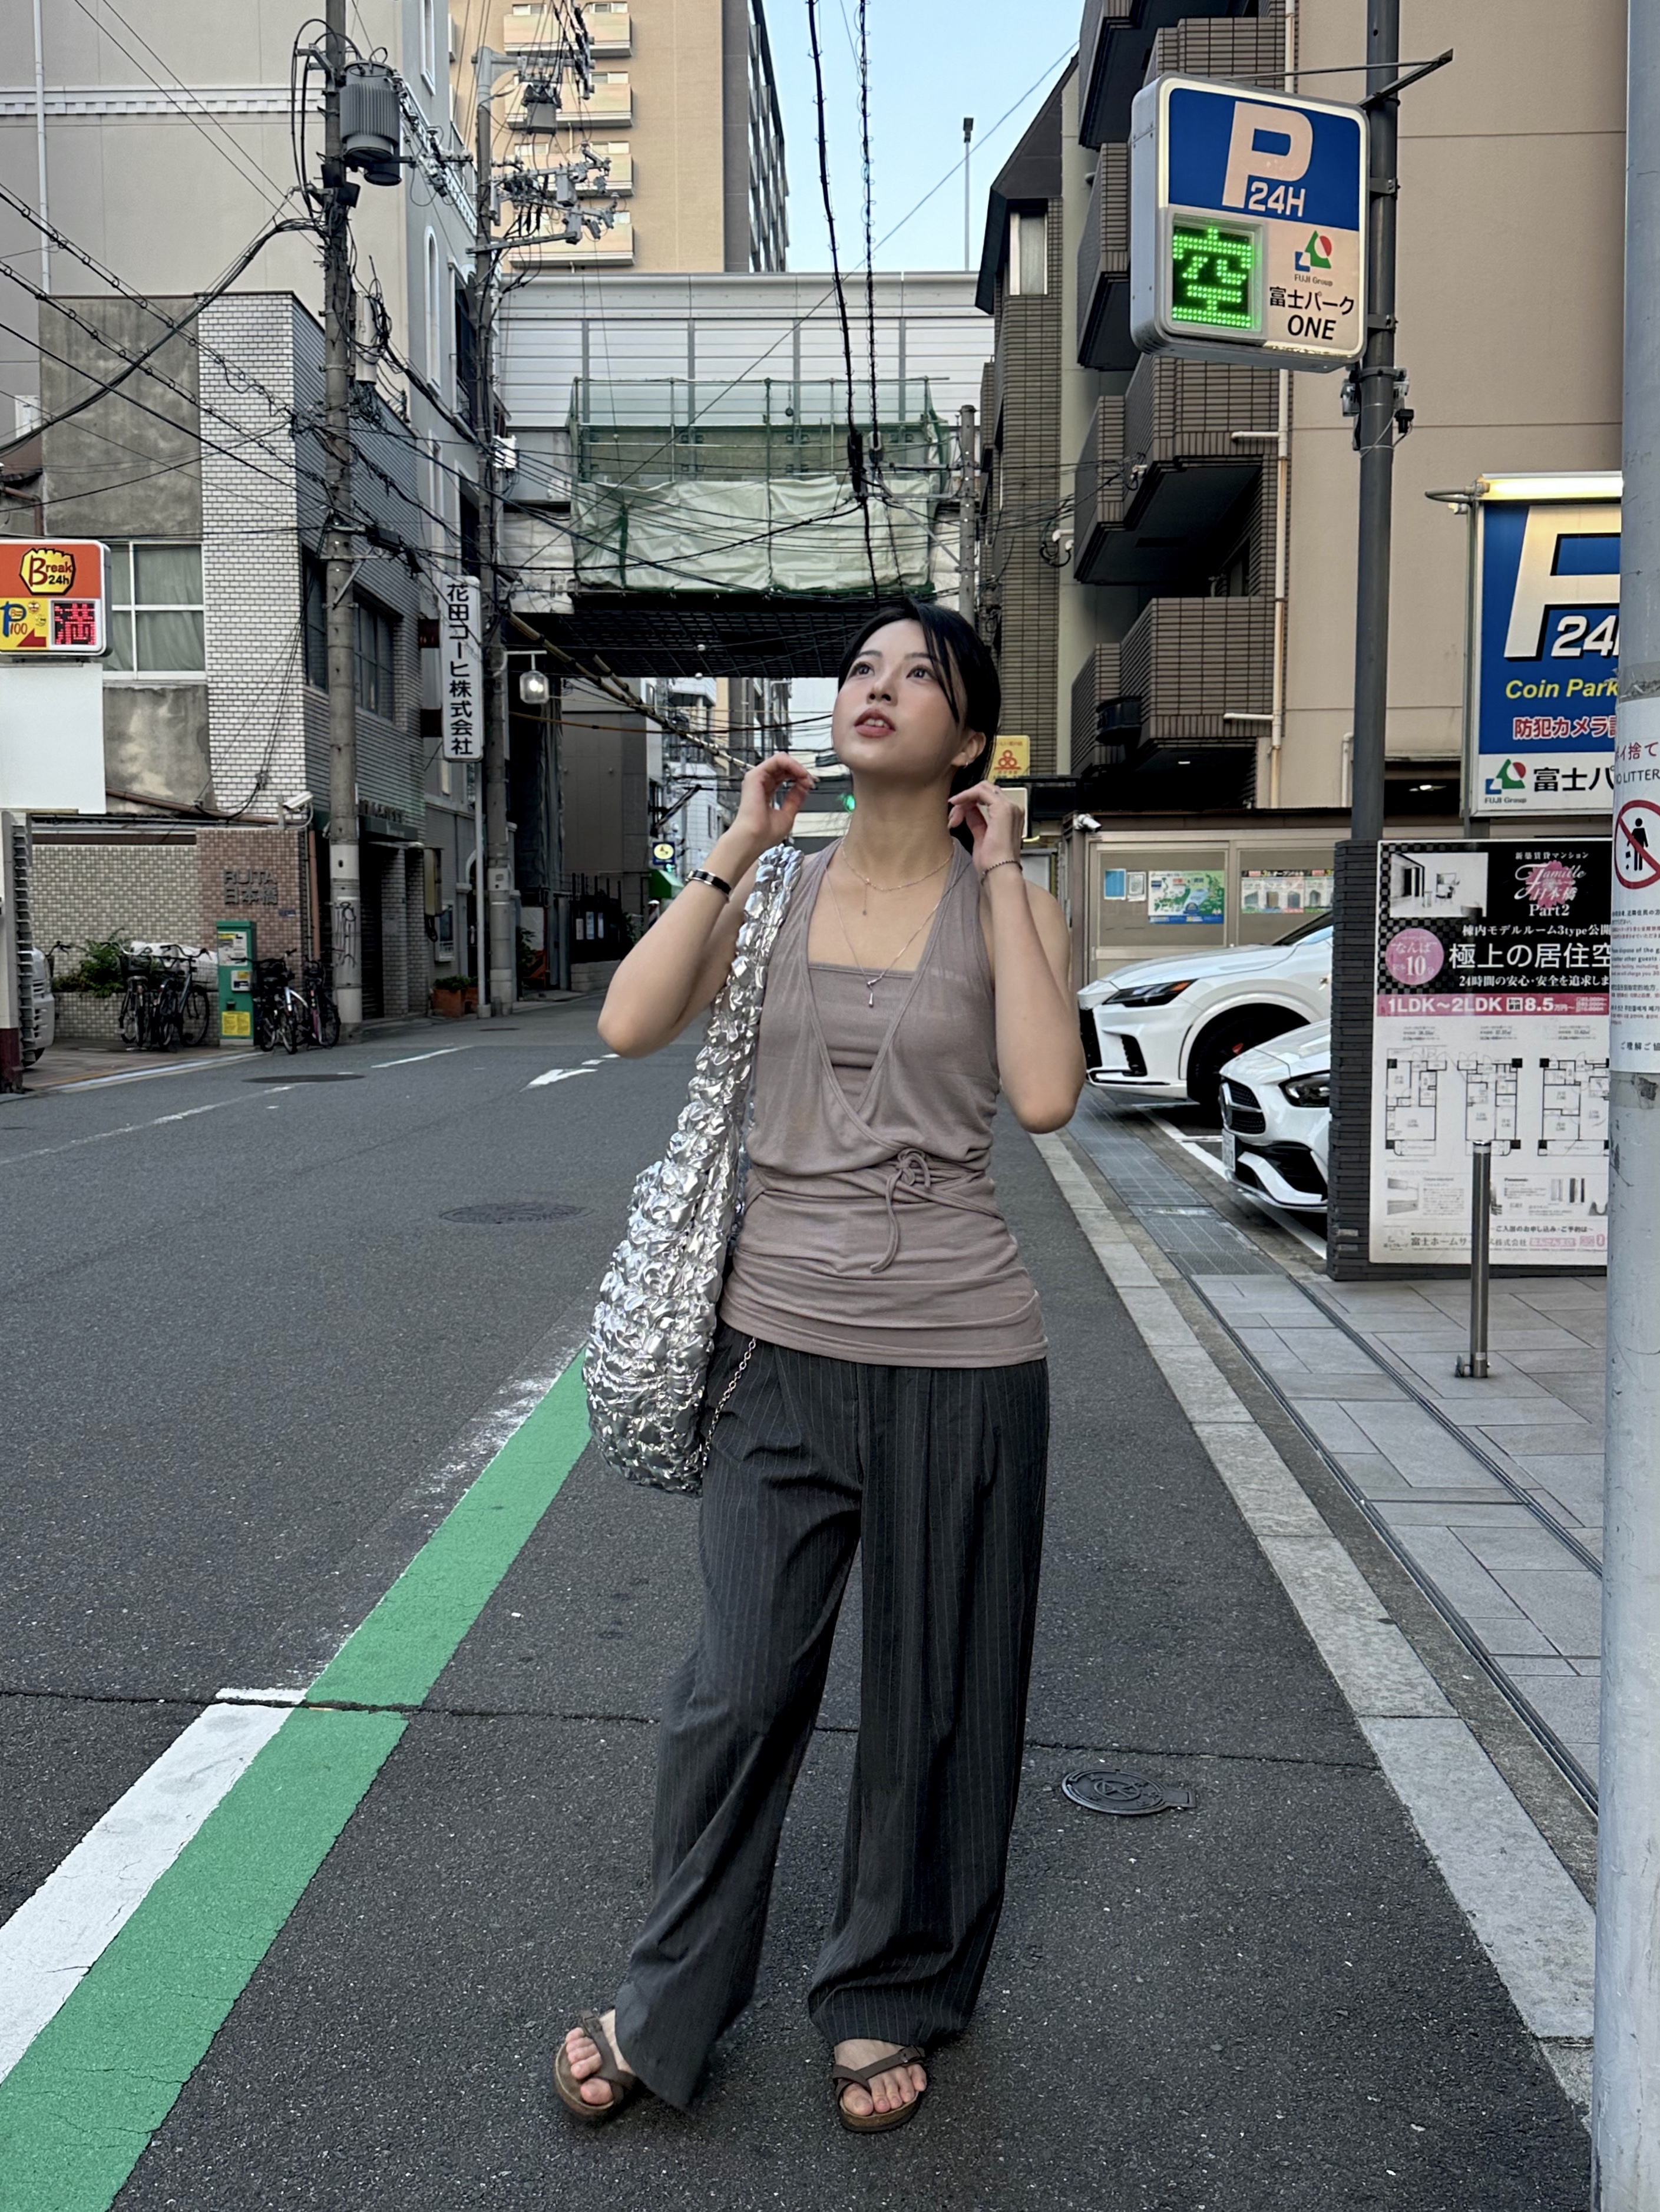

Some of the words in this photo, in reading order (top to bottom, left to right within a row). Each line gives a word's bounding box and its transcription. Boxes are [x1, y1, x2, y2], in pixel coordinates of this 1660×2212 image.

[1222, 101, 1314, 209] P
[1248, 181, 1307, 217] 24H
[1172, 228, 1252, 328] 空
[1294, 274, 1311, 283] FUJI
[1312, 276, 1333, 287] Group
[1269, 287, 1354, 315] 富士パーク
[1288, 315, 1337, 340] ONE
[28, 555, 72, 587] Break
[48, 574, 70, 585] 24h
[11, 623, 28, 635] 100
[54, 603, 97, 645] 満
[446, 583, 474, 756] 花田コーヒ株式会社
[1506, 679, 1560, 699] Coin
[224, 885, 278, 905] 日本橋
[1529, 904, 1570, 916] Part2
[1449, 943, 1611, 969] 極上の居住空
